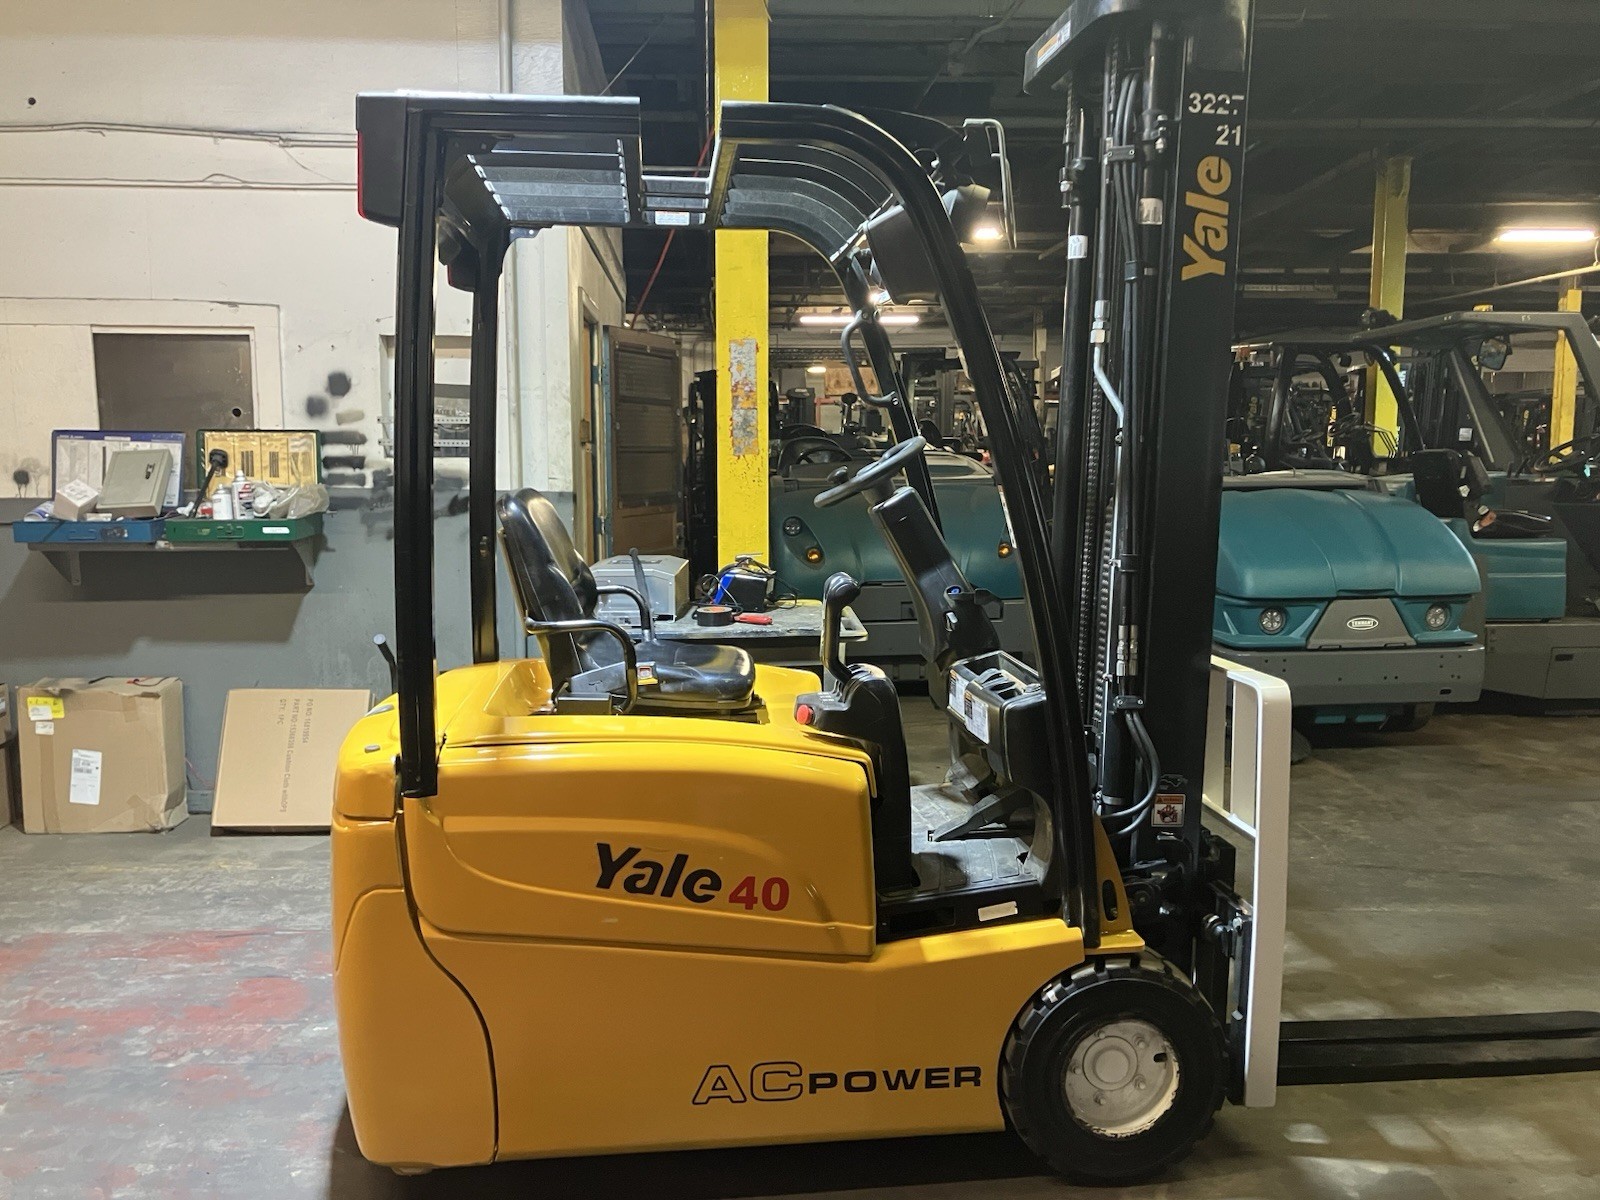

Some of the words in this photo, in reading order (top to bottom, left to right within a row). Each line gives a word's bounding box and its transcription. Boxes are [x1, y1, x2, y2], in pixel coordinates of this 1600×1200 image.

[1215, 124, 1241, 146] 21
[1181, 155, 1232, 280] Yale
[595, 842, 722, 903] Yale
[728, 876, 789, 911] 40
[692, 1061, 803, 1105] AC
[808, 1066, 981, 1094] POWER
